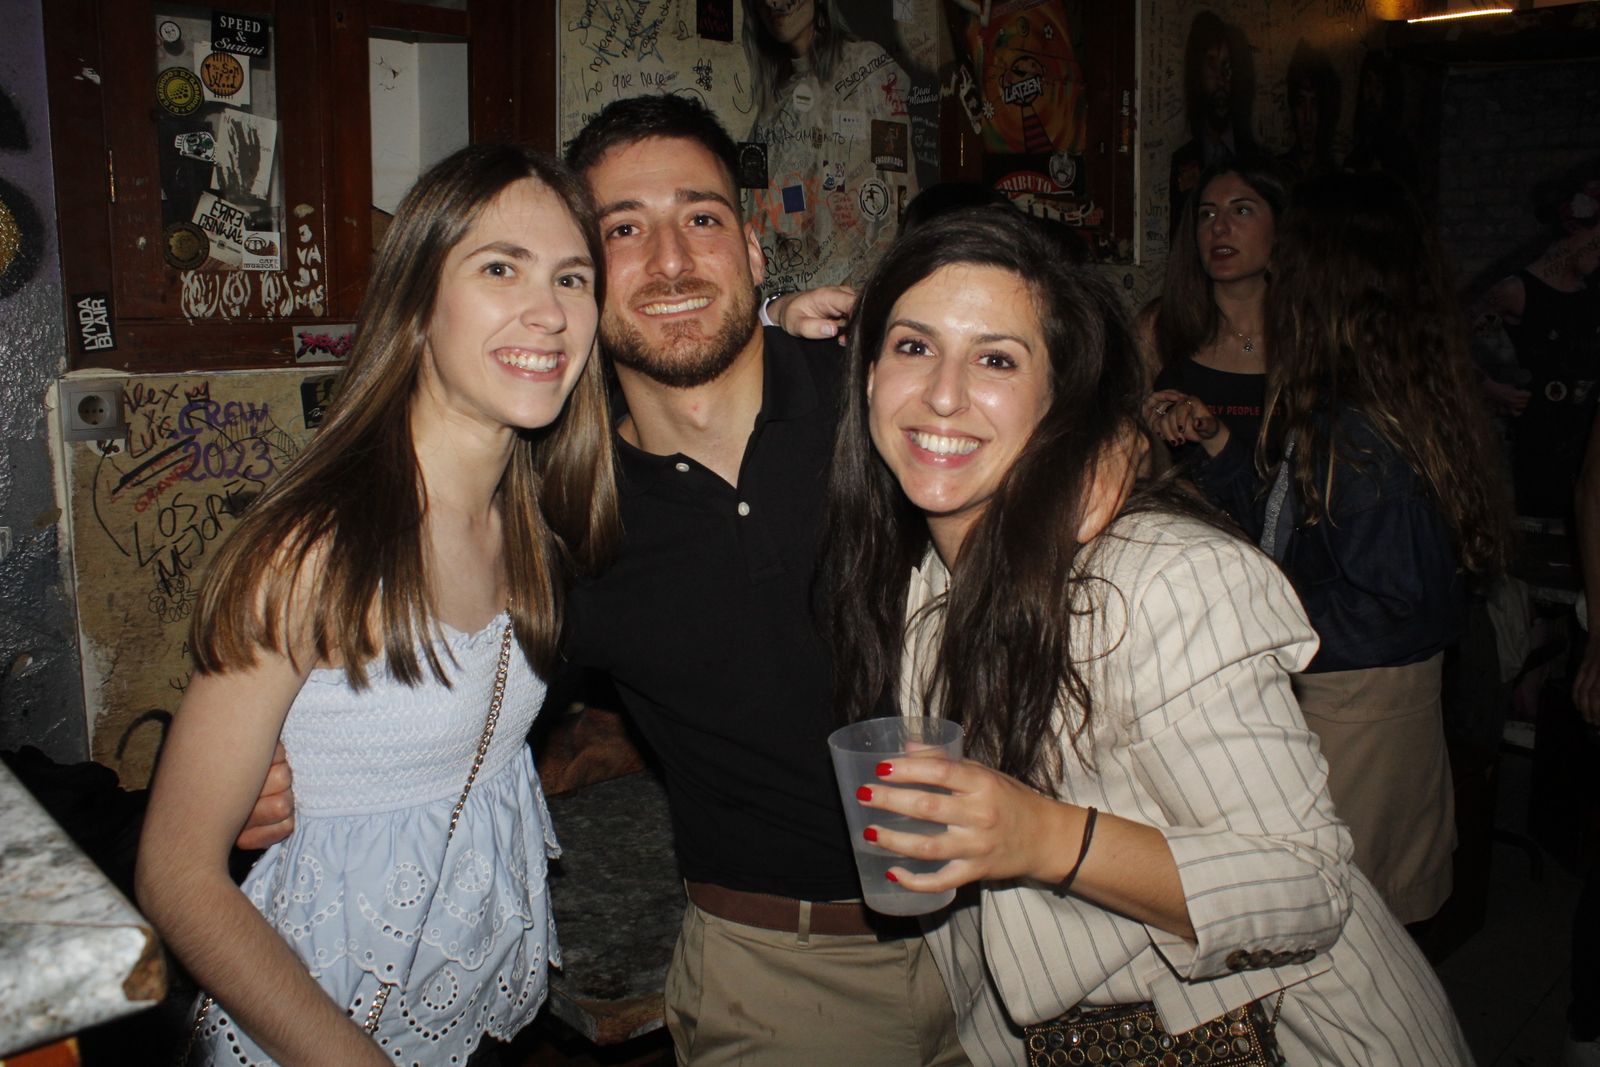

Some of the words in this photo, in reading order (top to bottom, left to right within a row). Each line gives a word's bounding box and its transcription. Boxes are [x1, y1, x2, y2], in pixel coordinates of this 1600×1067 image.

[219, 15, 261, 34] SPEED
[234, 30, 248, 43] &
[214, 37, 265, 56] Surimi
[77, 296, 99, 351] LYNDA
[93, 298, 114, 349] BLAIR
[178, 400, 269, 436] CREW
[1226, 405, 1262, 416] PEOPLE
[178, 440, 274, 482] 2023
